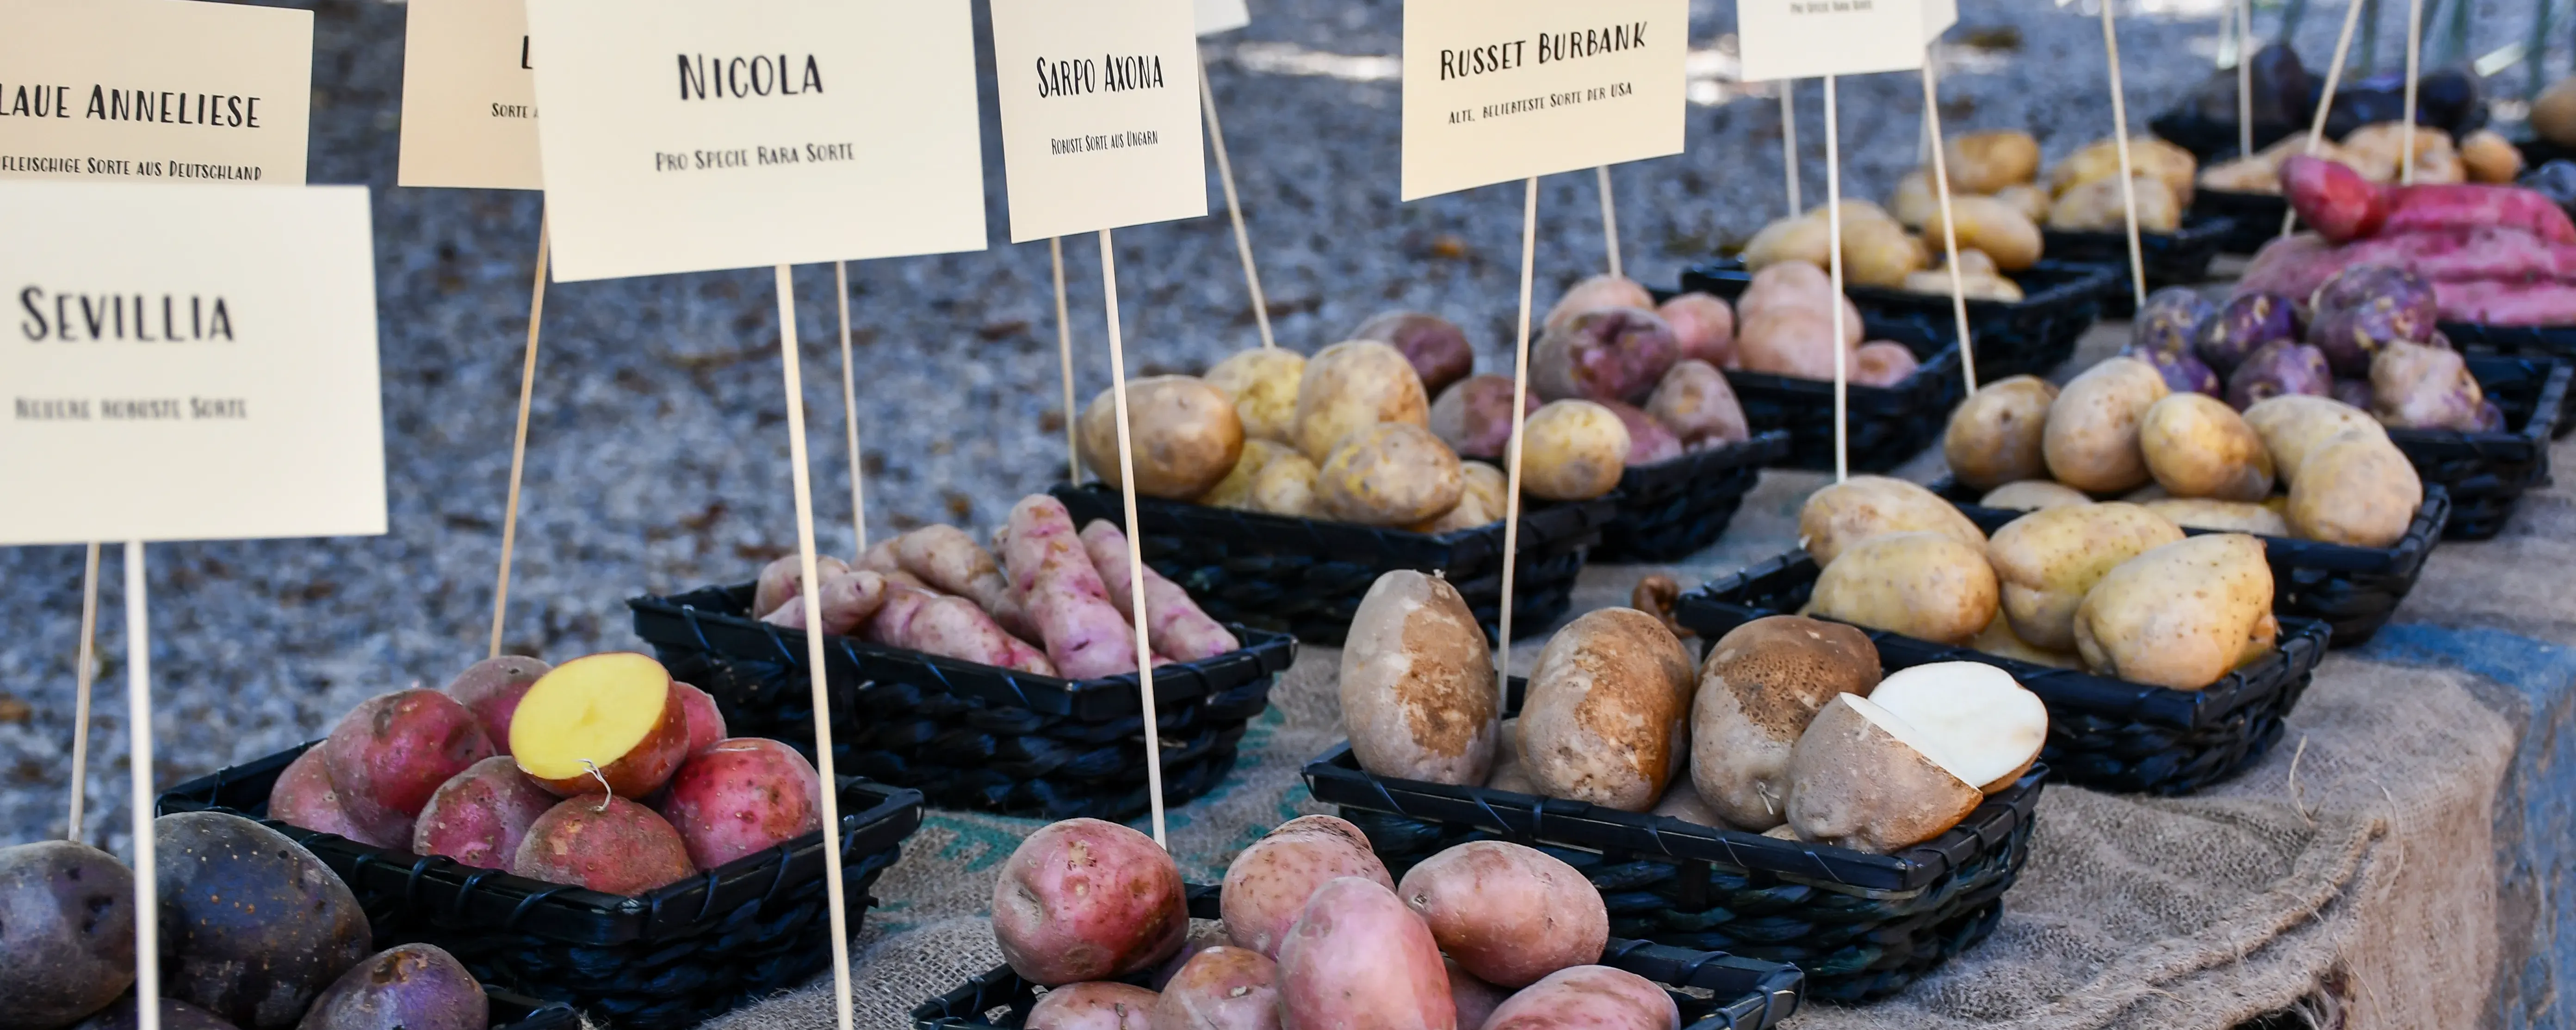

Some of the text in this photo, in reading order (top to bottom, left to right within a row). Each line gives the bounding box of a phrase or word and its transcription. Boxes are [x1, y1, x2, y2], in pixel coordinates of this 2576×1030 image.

[1440, 21, 1647, 81] RUSSET BURBANK
[677, 53, 824, 101] NICOLA
[1036, 53, 1164, 99] SARPO AXONA
[86, 83, 261, 129] ANNELIESE
[491, 102, 527, 119] SORTE
[1482, 97, 1544, 119] BELIEBTESTE
[1549, 91, 1581, 108] SORTE
[1587, 87, 1606, 102] DER
[1610, 82, 1632, 98] USA
[655, 142, 854, 173] PRO SPECIE RARA SORTE
[1051, 130, 1158, 156] ROBUSTE SORTE AUS UNGARN
[87, 156, 131, 176] SORTE
[136, 161, 162, 177] AUS
[169, 160, 262, 181] DEUTSCHLAND
[19, 285, 234, 342] SEVILLIA
[189, 395, 247, 420] SORTE
